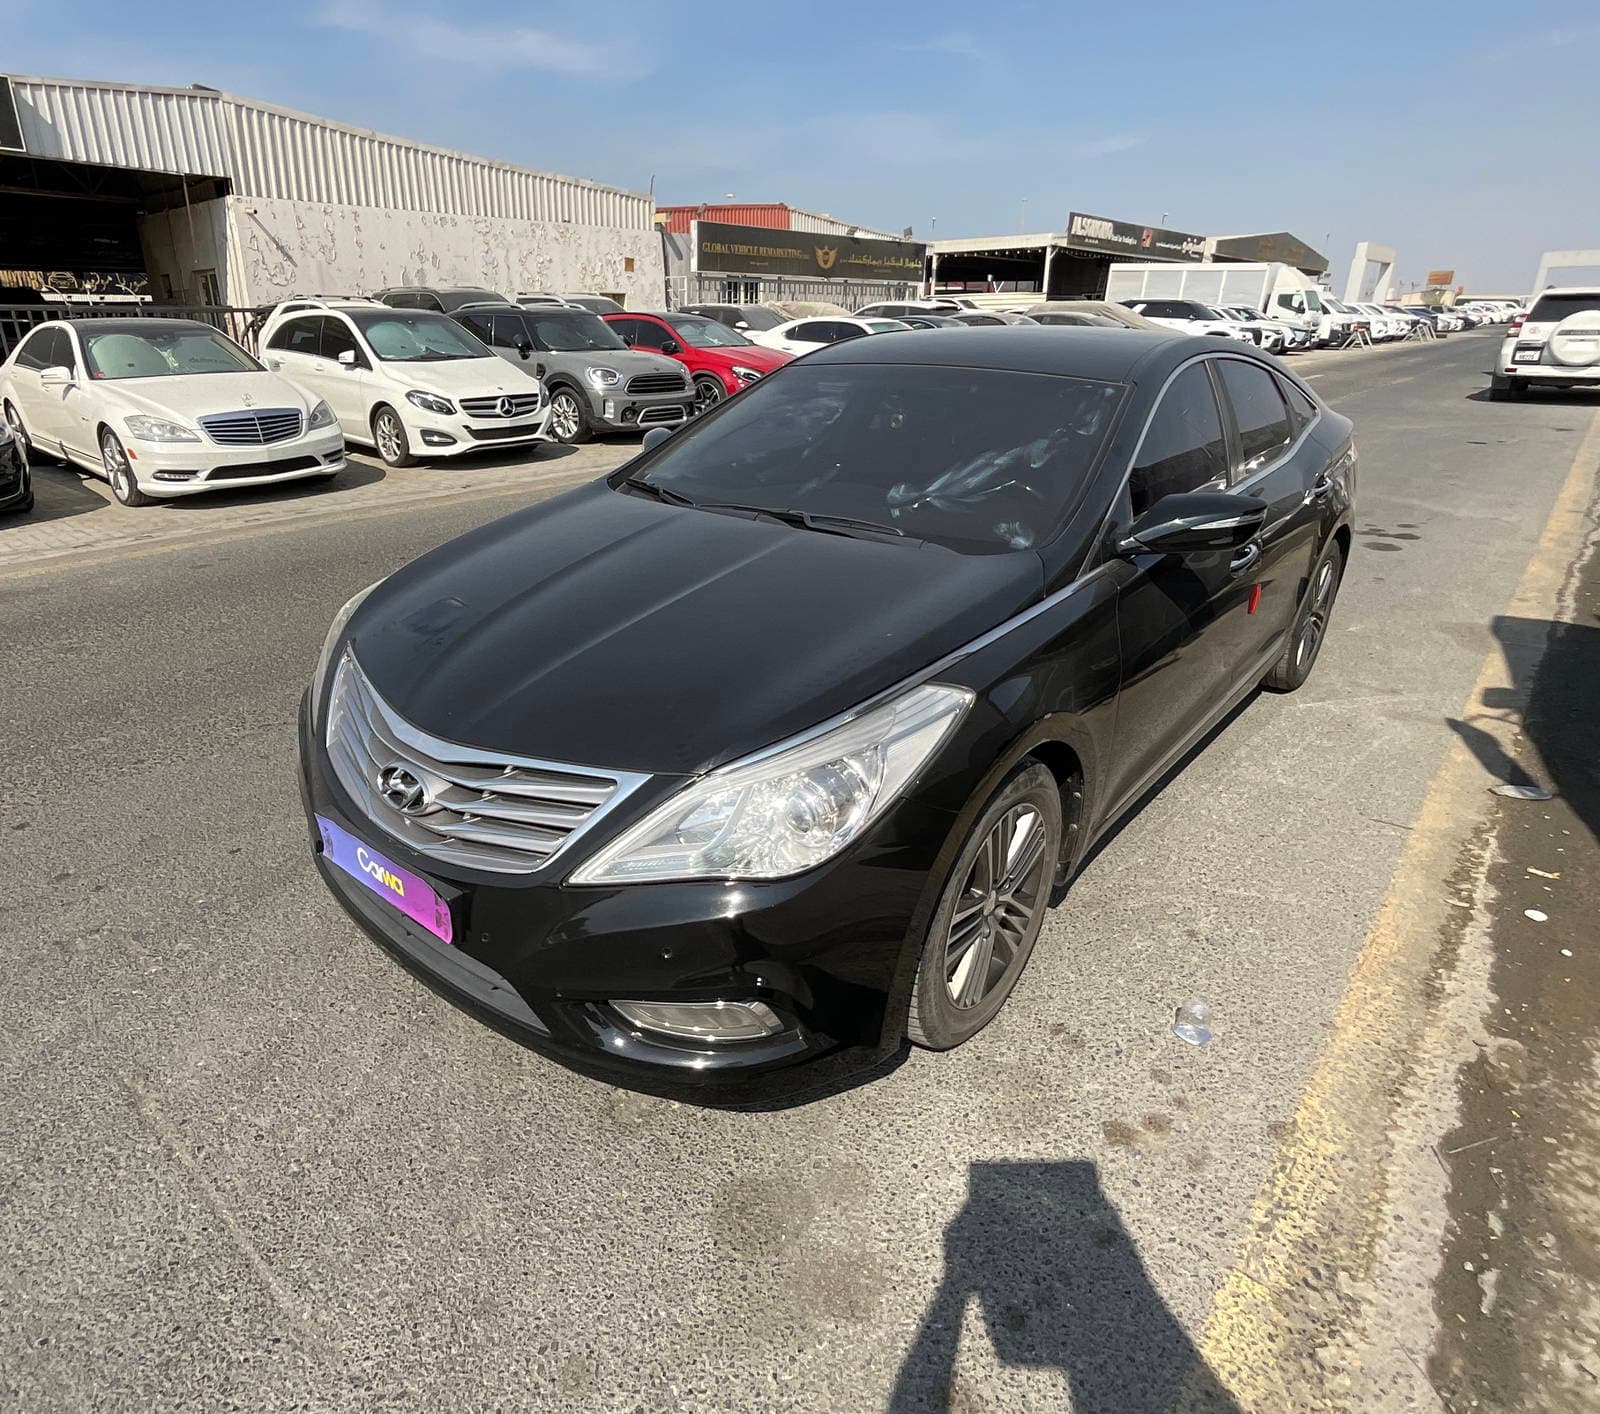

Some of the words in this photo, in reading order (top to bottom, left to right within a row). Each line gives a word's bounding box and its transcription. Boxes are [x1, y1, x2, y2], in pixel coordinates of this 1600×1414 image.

[702, 241, 729, 254] GLOBAL
[729, 243, 758, 256] VEHICLE
[759, 246, 802, 258] REMARKETING
[0, 270, 45, 290] MOTORS
